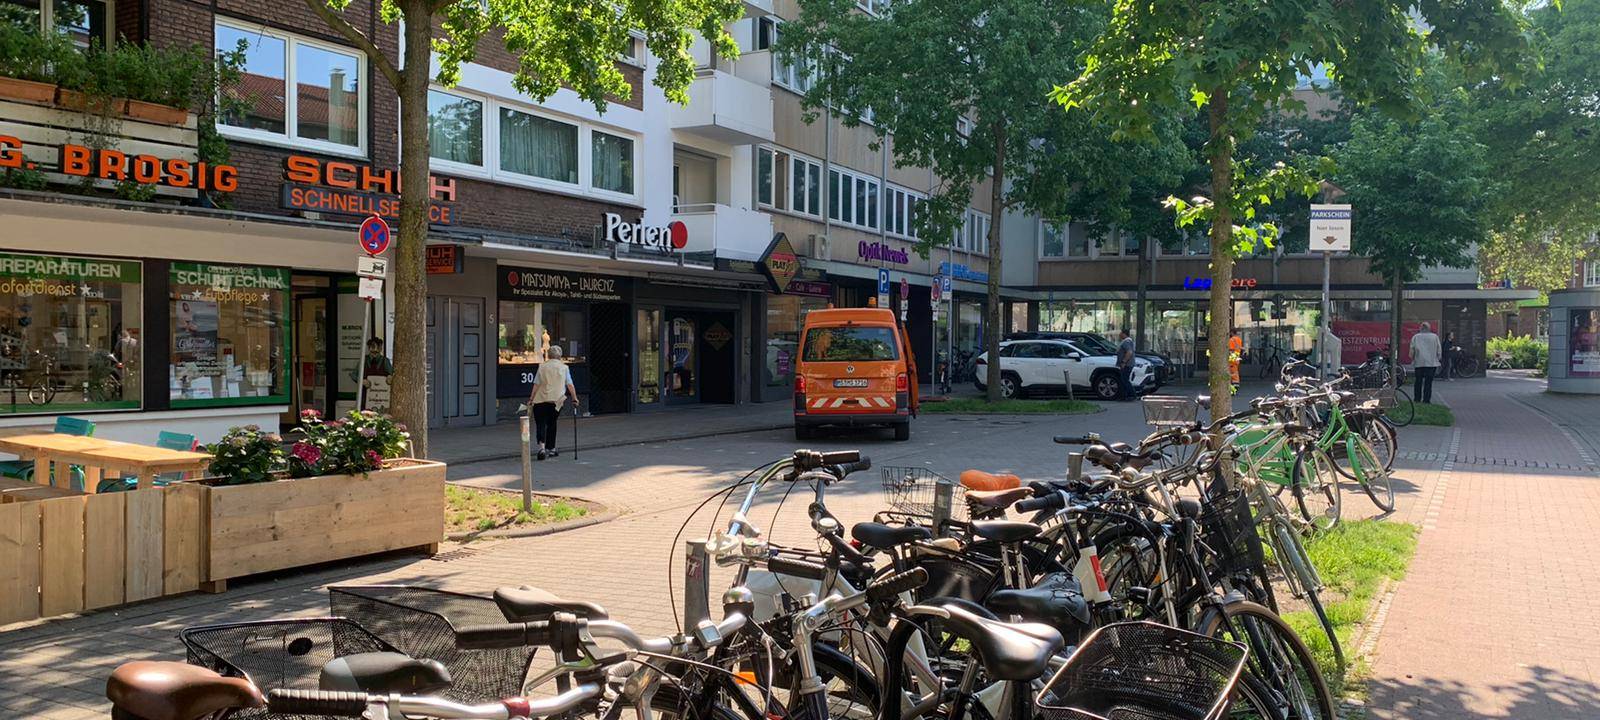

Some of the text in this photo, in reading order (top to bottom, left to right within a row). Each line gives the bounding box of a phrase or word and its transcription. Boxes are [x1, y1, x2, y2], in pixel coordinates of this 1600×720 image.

[63, 144, 239, 193] BROSIG
[287, 154, 456, 201] SCHH
[290, 187, 451, 224] SCHNELLSECE
[605, 212, 672, 247] Perlen
[0, 258, 121, 278] REPARATUREN
[1, 279, 76, 297] ofortdienst
[176, 271, 283, 289] SCHUHTECHNIK
[521, 272, 571, 289] MATSUMIYA
[580, 277, 615, 292] LAURENZ
[880, 271, 888, 291] P
[521, 288, 544, 296] Spezialist
